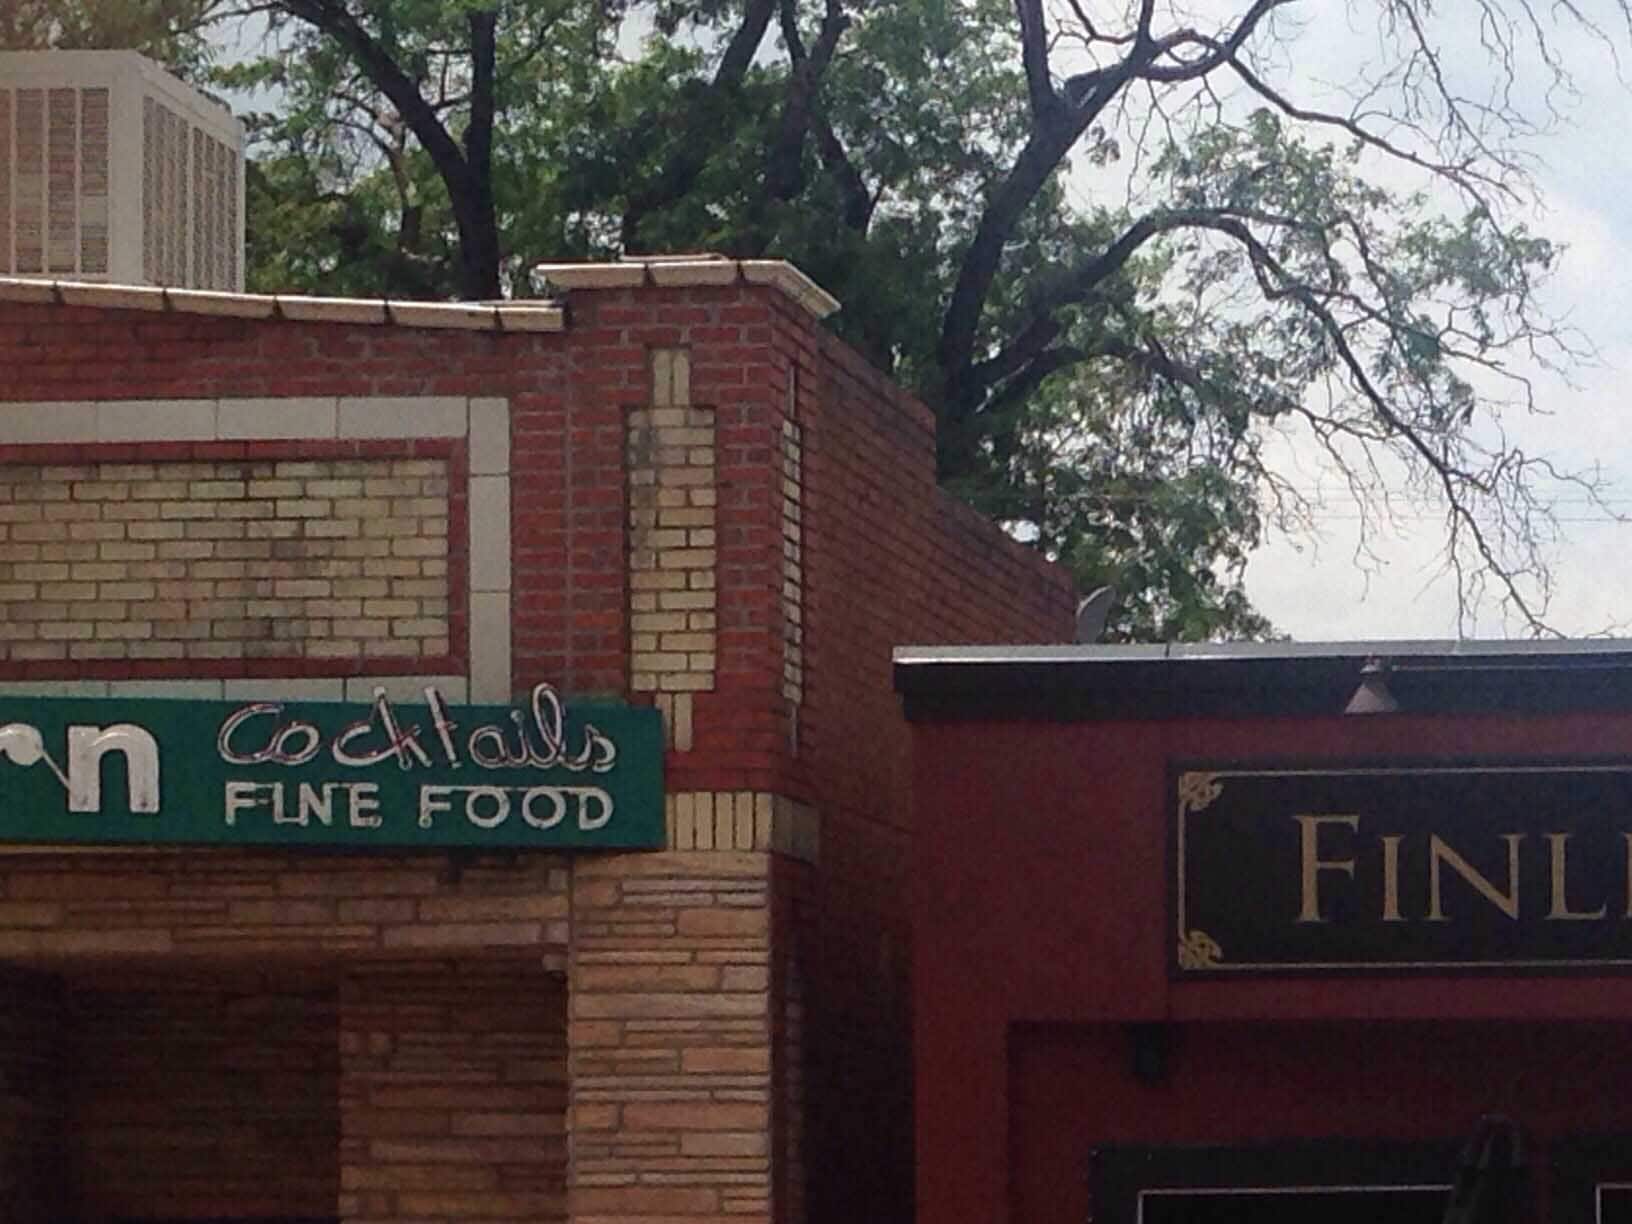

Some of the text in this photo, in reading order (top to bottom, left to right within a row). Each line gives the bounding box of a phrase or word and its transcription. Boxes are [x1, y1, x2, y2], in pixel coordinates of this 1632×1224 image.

[216, 683, 616, 774] Cocktails
[224, 781, 614, 829] FINE FOOD
